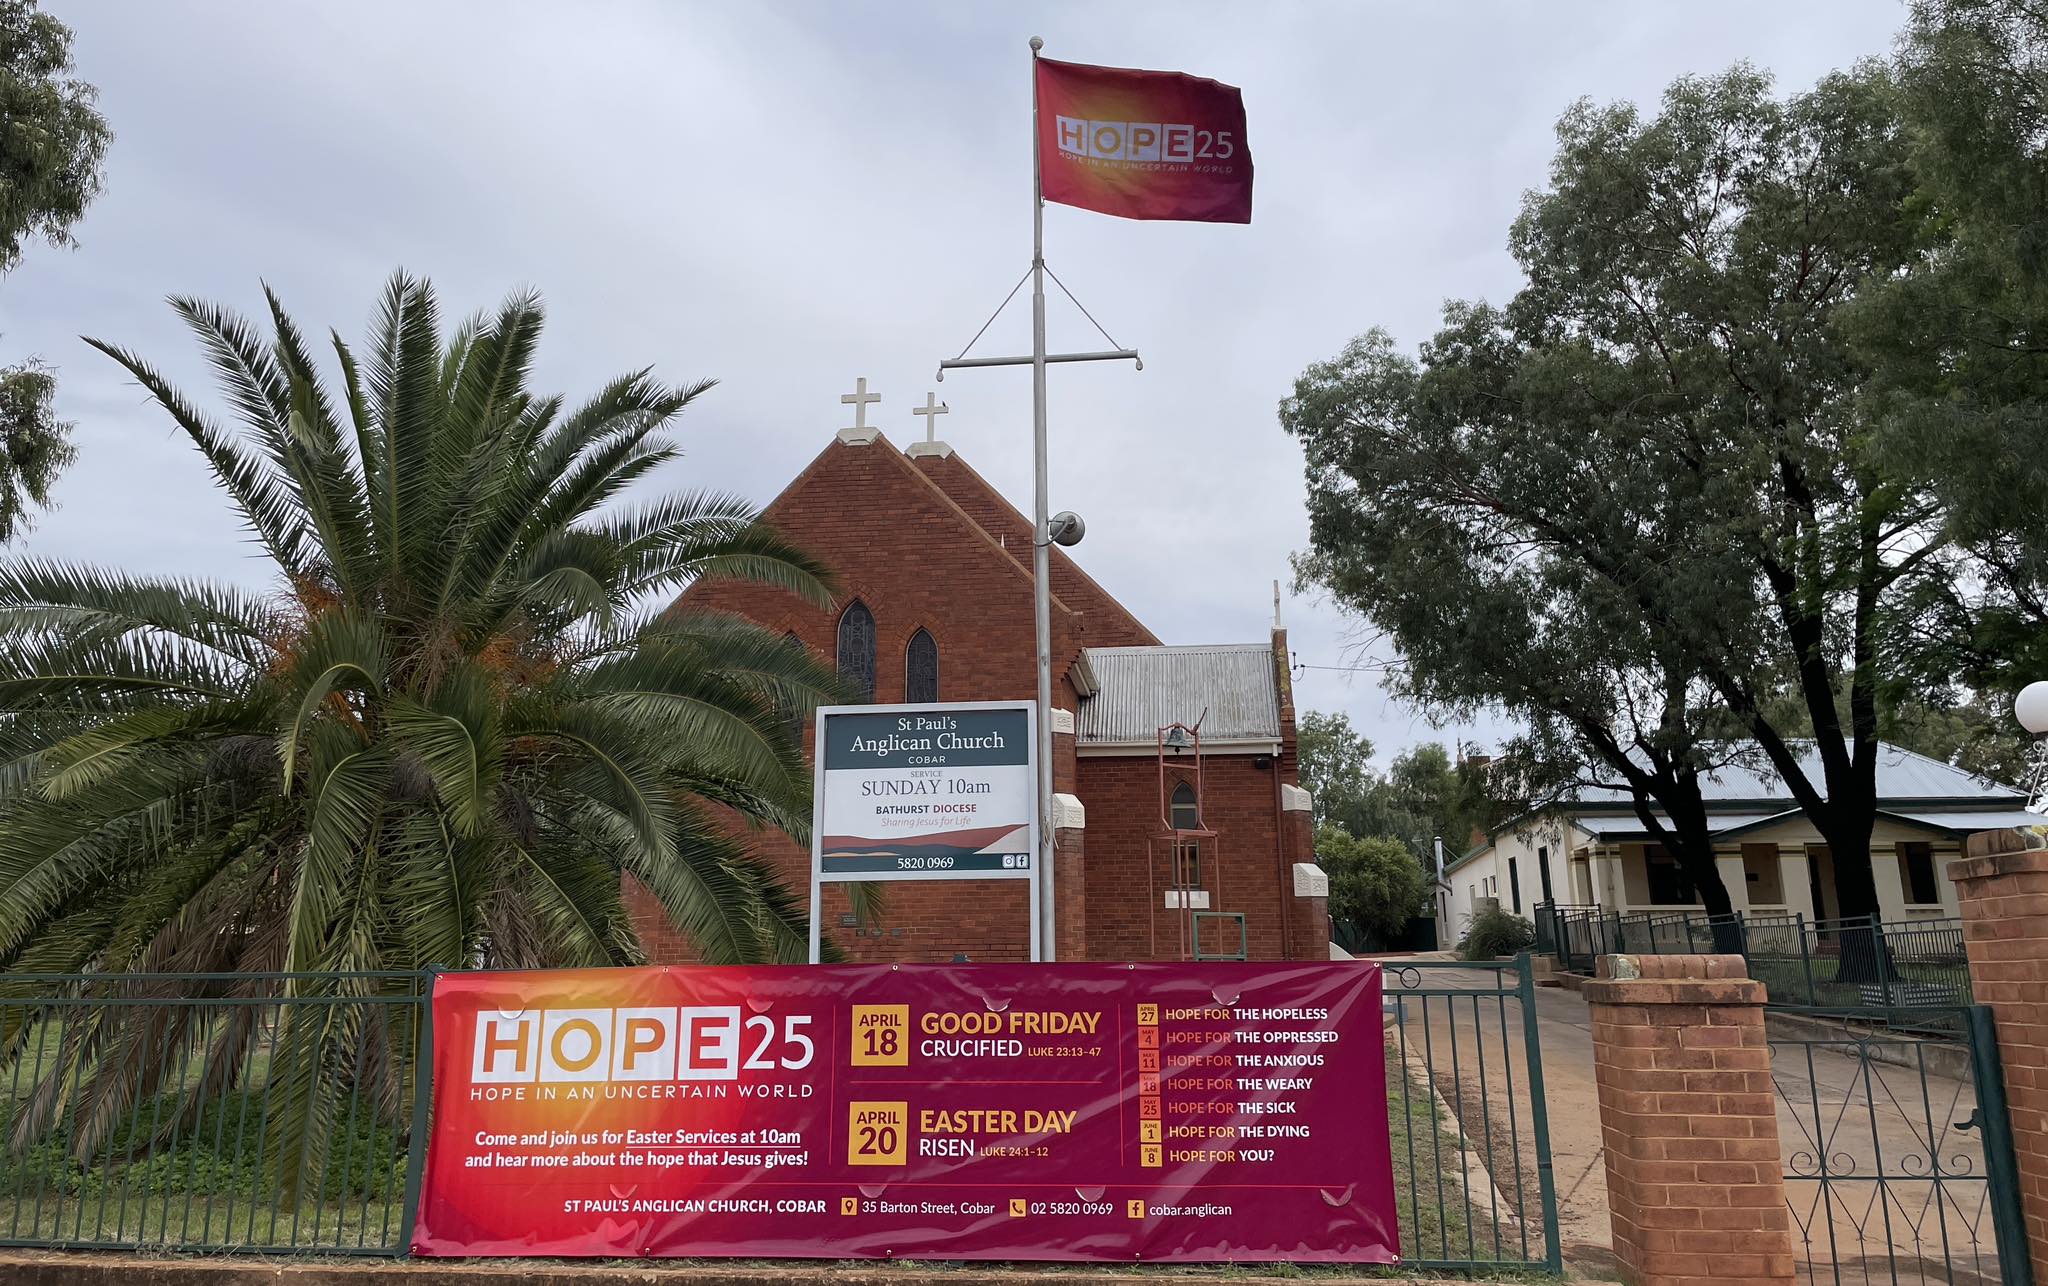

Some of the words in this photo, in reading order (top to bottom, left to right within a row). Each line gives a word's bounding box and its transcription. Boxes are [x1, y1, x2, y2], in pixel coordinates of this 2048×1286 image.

[1061, 120, 1233, 159] HOPE25
[1059, 151, 1083, 164] HOPE
[1088, 158, 1098, 166] IN
[1104, 161, 1118, 169] AN
[1123, 161, 1188, 172] UNCERTAIN
[898, 718, 912, 731] St
[916, 717, 957, 730] Paul's
[850, 734, 931, 756] Anglican
[937, 732, 1005, 749] Church
[909, 756, 946, 764] COBAR
[862, 780, 940, 796] SUNDAY
[947, 779, 991, 794] 10am
[876, 805, 929, 815] BATHURST
[933, 804, 976, 813] DIOCESE
[881, 818, 915, 828] Sharing
[916, 818, 939, 827] Jesus
[939, 817, 954, 827] for
[955, 816, 971, 826] Life
[898, 858, 924, 869] 5820
[927, 857, 954, 868] 0969
[1141, 1012, 1154, 1021] 27
[1166, 1009, 1200, 1019] HOPE
[1205, 1009, 1230, 1019] FOR
[1234, 1009, 1260, 1020] THE
[1263, 1008, 1328, 1020] HOPELESS
[859, 1014, 901, 1027] APRIL
[921, 1012, 1002, 1034] GOOD
[1009, 1012, 1101, 1034] FRIDAY
[864, 1029, 898, 1056] 18
[1145, 1035, 1152, 1045] 4
[1167, 1032, 1202, 1042] HOPE
[1206, 1032, 1231, 1042] FOR
[1235, 1032, 1261, 1042] THE
[1264, 1032, 1338, 1042] OPPRESSED
[482, 1015, 814, 1072] HOPE25
[921, 1040, 1022, 1057] CRUCIFIED
[1028, 1048, 1053, 1057] LUKE
[1143, 1059, 1155, 1068] 11
[1168, 1056, 1202, 1066] HOPE
[1207, 1056, 1232, 1066] FOR
[1236, 1055, 1262, 1066] THE
[1264, 1055, 1324, 1066] ANXIOUS
[1144, 1082, 1156, 1091] 18
[1168, 1079, 1203, 1089] HOPE
[1207, 1079, 1233, 1089] FOR
[1237, 1079, 1263, 1089] THE
[1265, 1078, 1312, 1089] WEARY
[470, 1087, 525, 1100] HOPE
[537, 1087, 555, 1099] IN
[567, 1087, 594, 1099] AN
[605, 1085, 727, 1098] UNCERTAIN
[738, 1084, 813, 1098] WORLD
[1144, 1106, 1157, 1115] 25
[1169, 1103, 1204, 1113] HOPE
[1208, 1103, 1234, 1113] FOR
[1238, 1103, 1264, 1113] THE
[1266, 1102, 1295, 1113] SICK
[857, 1111, 900, 1124] APRIL
[921, 1110, 1017, 1133] EASTER
[1024, 1110, 1077, 1133] DAY
[1148, 1130, 1153, 1139] 1
[1170, 1127, 1205, 1137] HOPE
[1209, 1126, 1235, 1137] FOR
[1239, 1126, 1264, 1137] THE
[1267, 1126, 1309, 1137] DYING
[475, 1130, 516, 1145] Come
[519, 1131, 546, 1145] and
[549, 1130, 578, 1150] join
[581, 1133, 598, 1145] us
[602, 1130, 623, 1145] for
[626, 1130, 672, 1145] Easter
[675, 1129, 736, 1144] Services
[740, 1131, 756, 1144] at
[760, 1130, 800, 1144] 10am
[858, 1127, 897, 1155] 20
[920, 1140, 974, 1156] RISEN
[980, 1147, 1006, 1156] LUKE
[465, 1152, 492, 1166] and
[496, 1152, 527, 1166] hear
[531, 1155, 568, 1166] more
[572, 1151, 616, 1166] about
[619, 1151, 644, 1166] the
[647, 1151, 684, 1169] hope
[688, 1151, 717, 1166] that
[721, 1151, 761, 1166] Jesus
[764, 1151, 807, 1168] gives!
[1148, 1153, 1155, 1163] 8
[1170, 1151, 1206, 1161] HOPE
[1210, 1151, 1235, 1161] FOR
[1240, 1150, 1274, 1161] YOU?
[564, 1201, 580, 1213] ST
[584, 1200, 629, 1213] PAUL'S
[632, 1200, 705, 1213] ANGLICAN
[708, 1199, 772, 1214] CHURCH,
[777, 1199, 825, 1212] COBAR
[862, 1202, 877, 1213] 35
[880, 1202, 918, 1213] Barton
[921, 1202, 957, 1214] Street,
[961, 1203, 995, 1214] Cobar
[1031, 1203, 1046, 1214] 02
[1050, 1203, 1080, 1214] 5820
[1083, 1204, 1112, 1215] 0969
[1150, 1204, 1232, 1217] cobar.anglican
